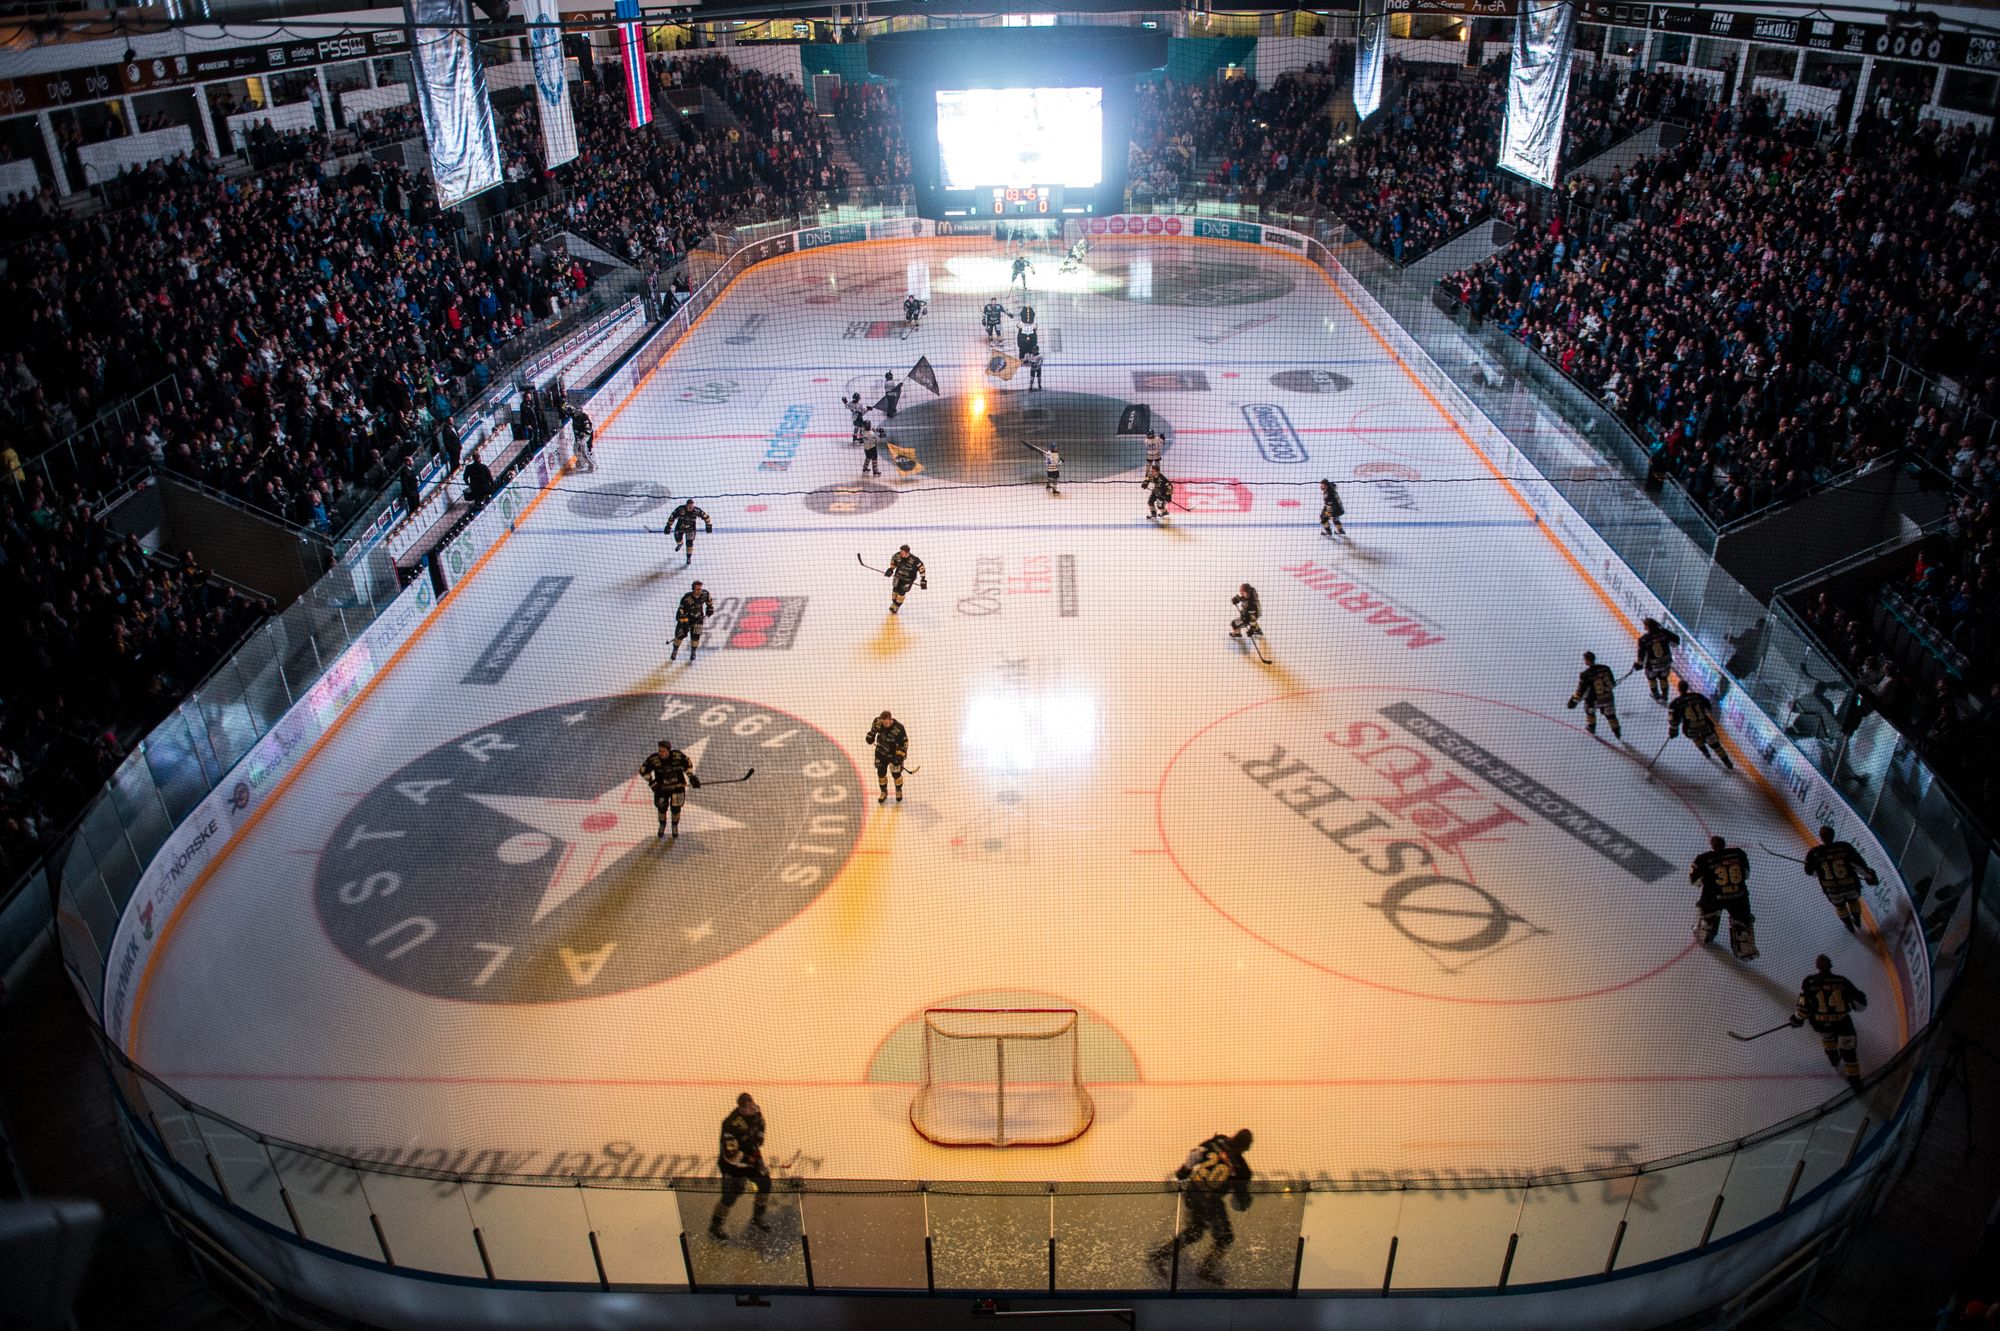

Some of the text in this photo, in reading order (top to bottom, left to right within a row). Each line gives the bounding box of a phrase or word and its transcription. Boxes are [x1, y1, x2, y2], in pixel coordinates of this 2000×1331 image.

[806, 231, 832, 246] DNB
[1202, 222, 1230, 238] DNB
[1281, 561, 1446, 649] MARVIK
[658, 694, 801, 750] 1994
[1323, 721, 1530, 855] HUS
[338, 732, 616, 987] ALUSTAR
[1815, 989, 1847, 1014] 14
